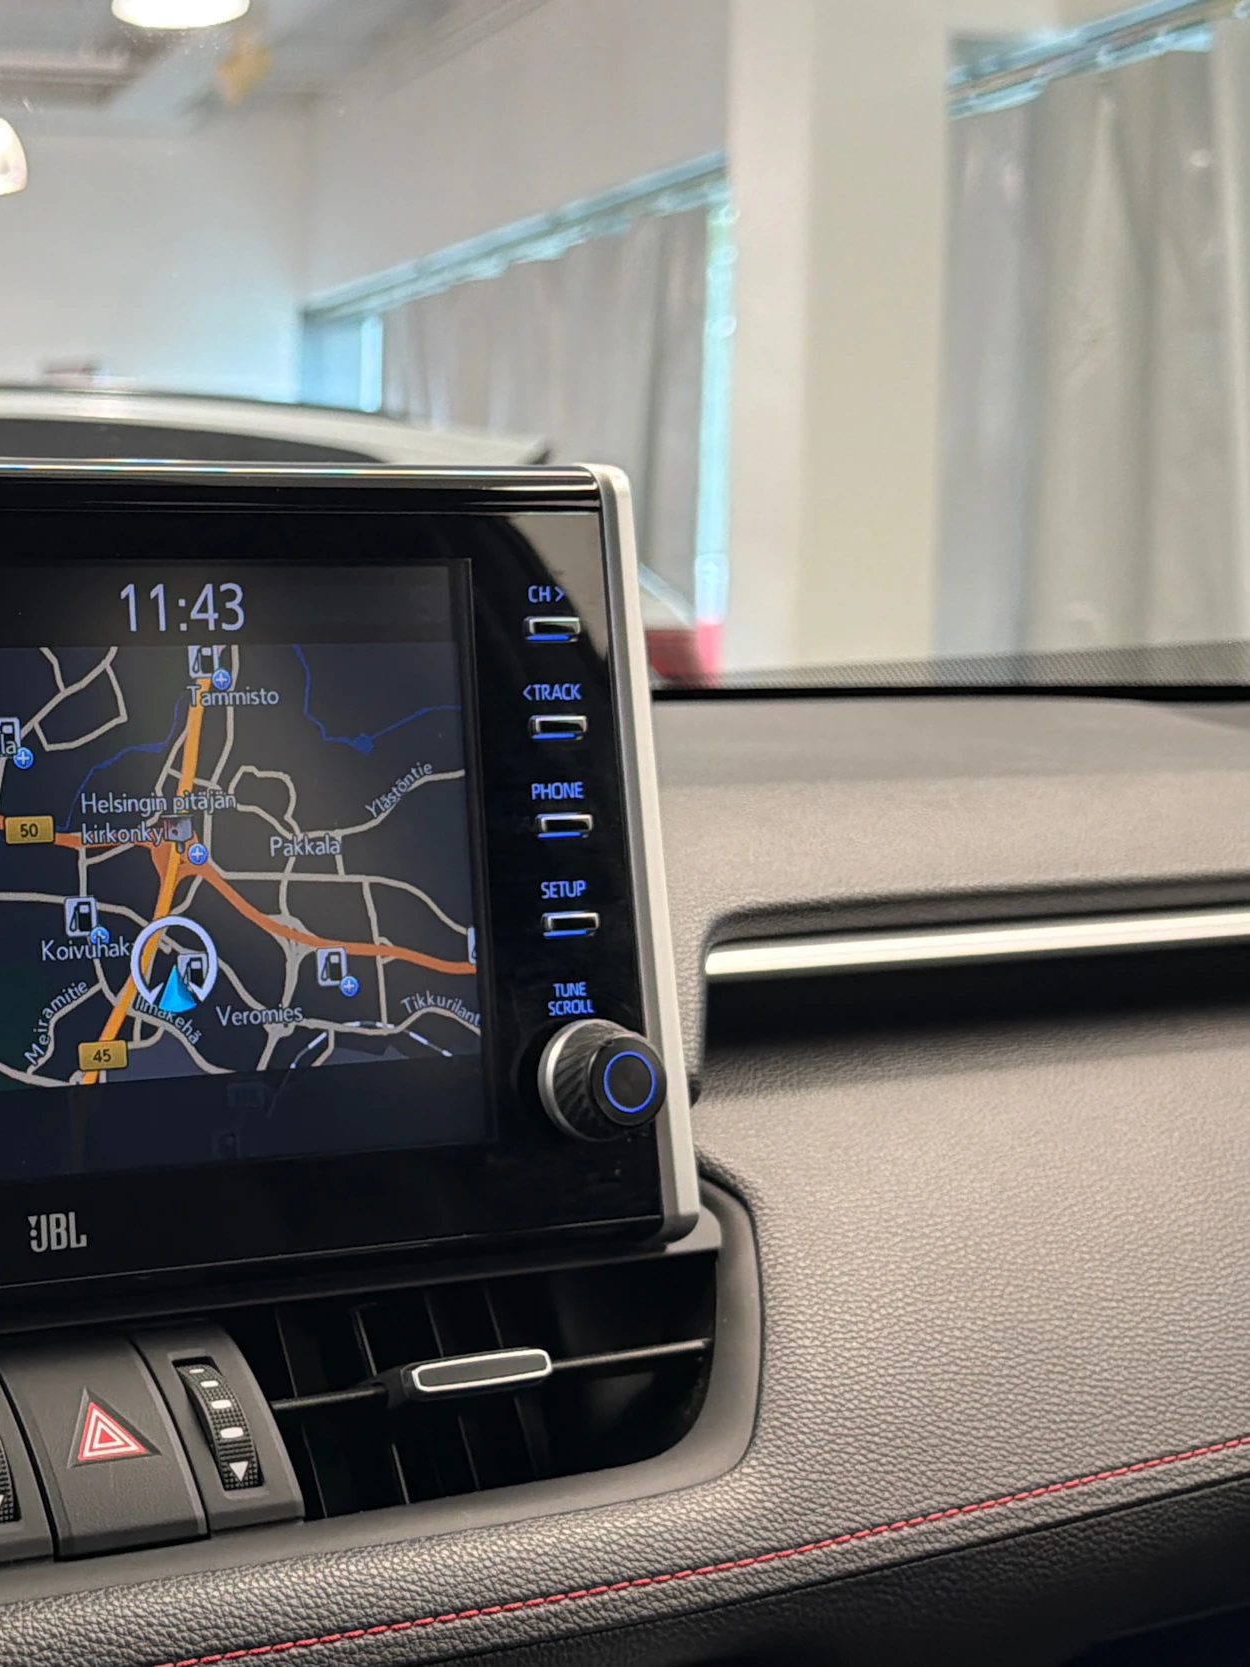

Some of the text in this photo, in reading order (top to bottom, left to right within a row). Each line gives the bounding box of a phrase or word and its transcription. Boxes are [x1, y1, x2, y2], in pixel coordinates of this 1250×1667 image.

[528, 585, 551, 603] CH
[120, 582, 246, 633] 11:43
[186, 684, 280, 708] Tammisto
[534, 684, 582, 701] TRACK
[364, 760, 433, 819] Ylästöntie
[531, 782, 584, 800] PHONE
[81, 787, 238, 818] Helsingin pitäjän
[19, 823, 39, 841] 50
[82, 820, 170, 848] kirkonkyl
[269, 833, 342, 858] Pakkala
[540, 880, 587, 899] SETUP
[41, 935, 133, 962] Koivuhak
[552, 982, 587, 998] TUNE
[215, 1004, 304, 1028] Veromies
[548, 1000, 595, 1016] SCROLL
[24, 980, 89, 1067] Meiramitie
[93, 1048, 112, 1064] 45
[28, 1211, 87, 1252] JBL
